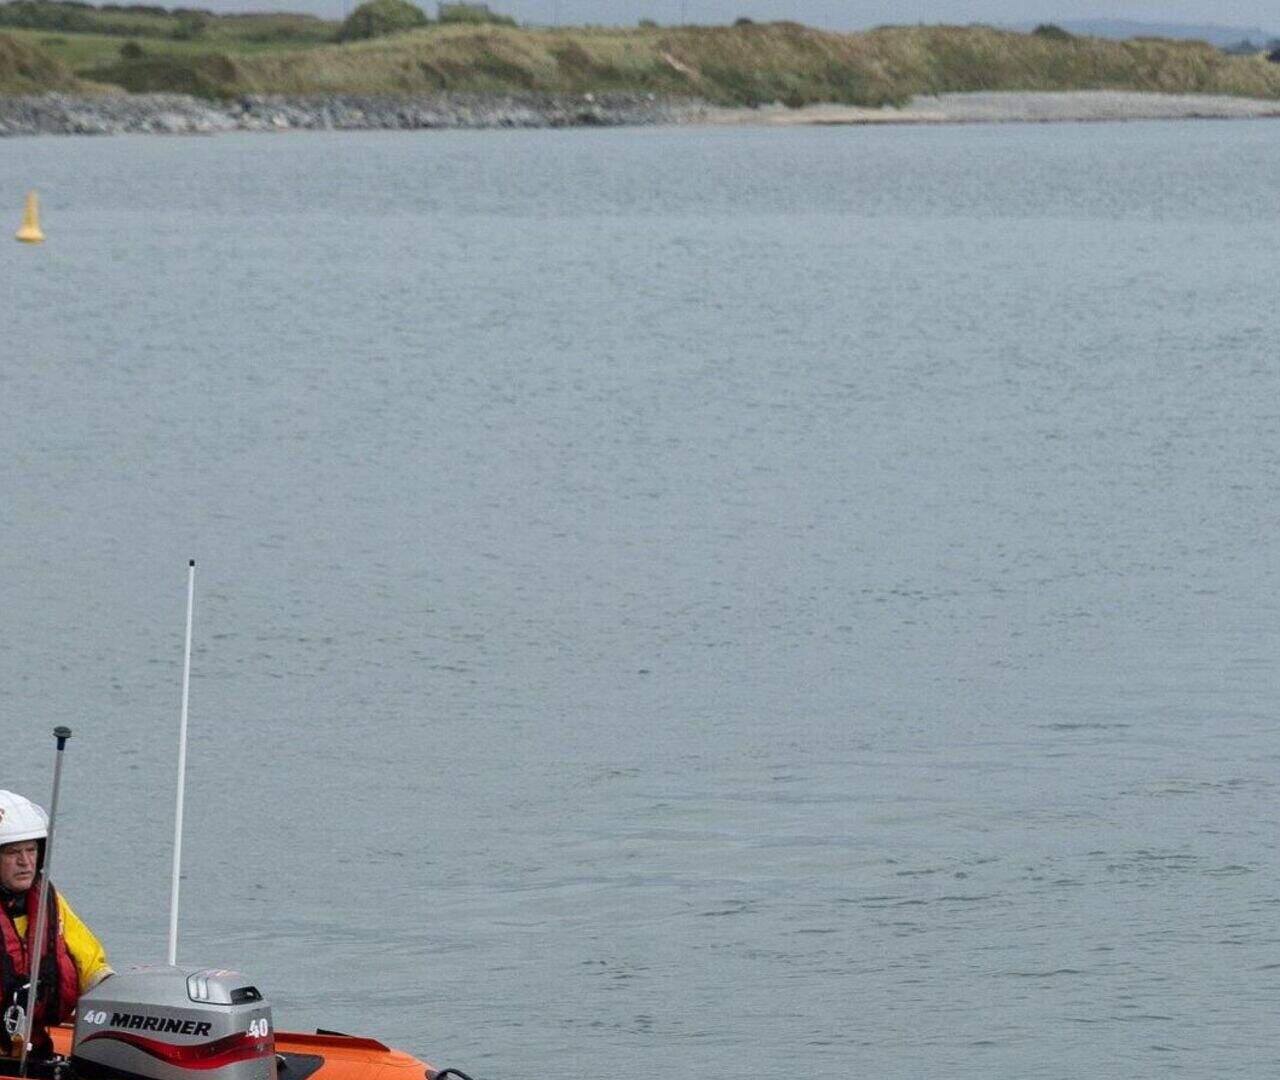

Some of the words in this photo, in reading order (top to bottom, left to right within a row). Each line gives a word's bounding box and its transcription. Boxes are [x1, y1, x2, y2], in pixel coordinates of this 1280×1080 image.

[84, 1010, 107, 1025] 40
[110, 1013, 212, 1036] MARINER
[246, 1018, 268, 1038] 40
